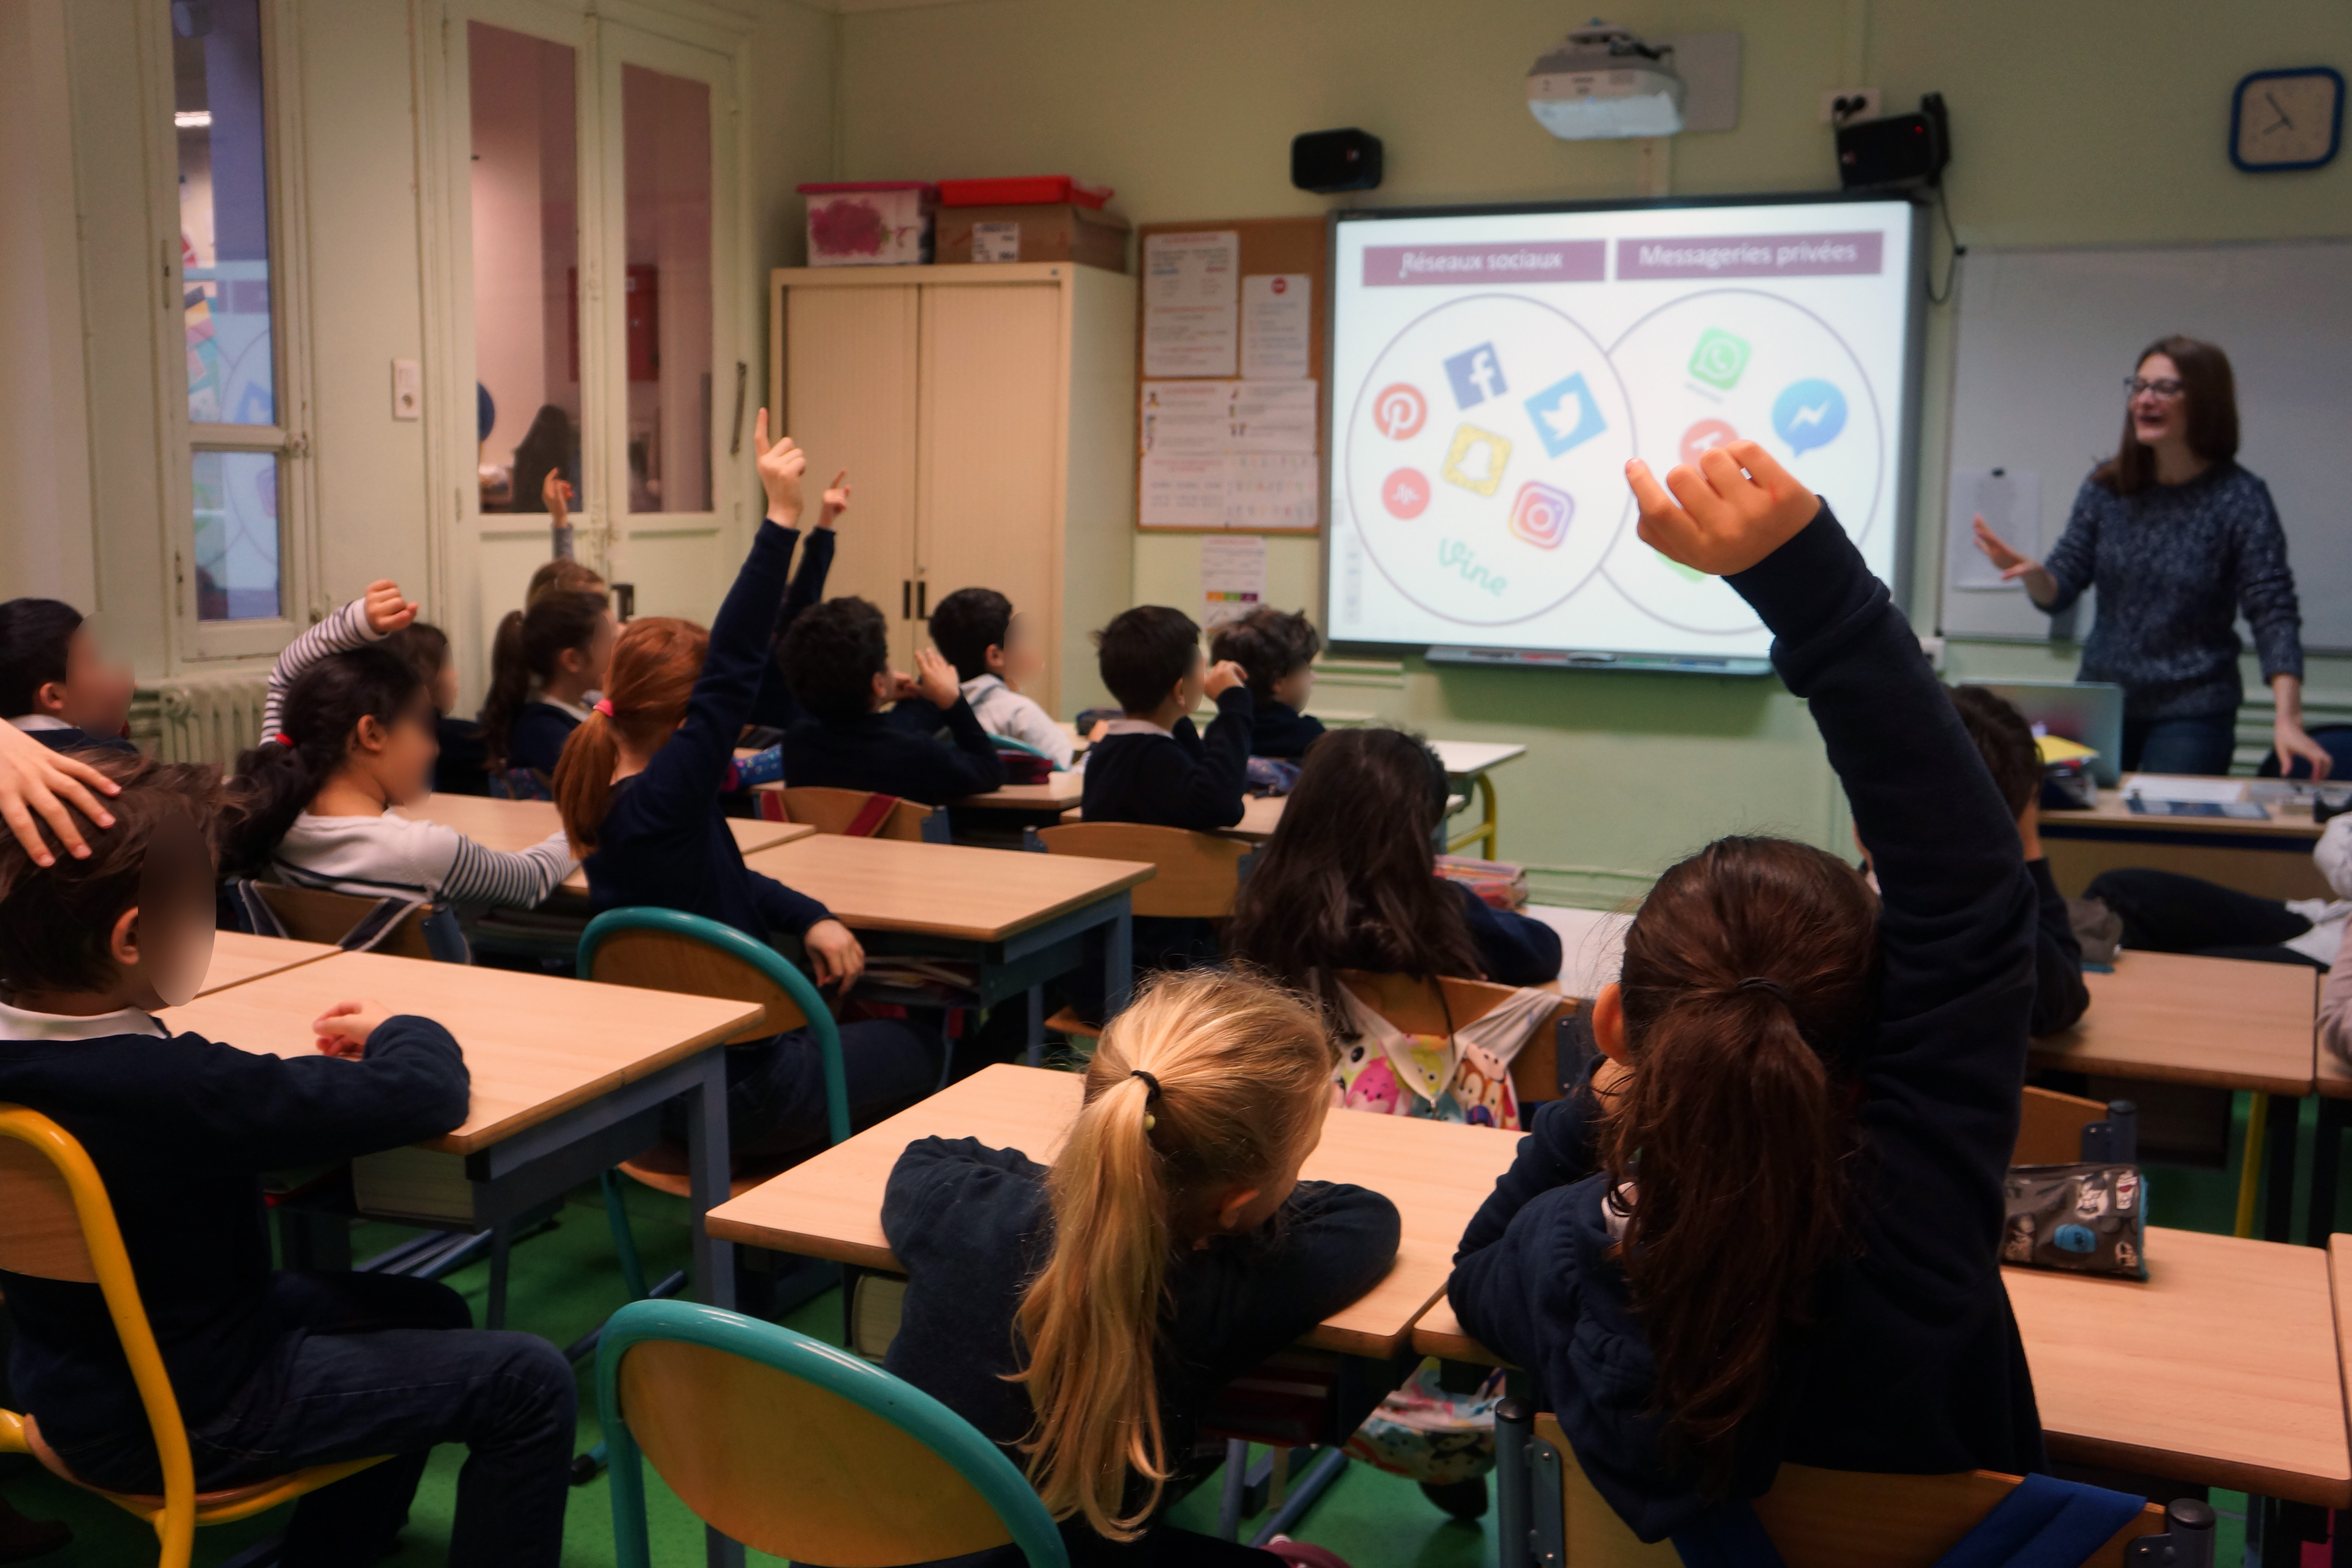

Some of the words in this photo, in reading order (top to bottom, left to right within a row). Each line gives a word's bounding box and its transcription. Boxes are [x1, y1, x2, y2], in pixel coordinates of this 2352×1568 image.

[1487, 249, 1563, 270] sociaux
[1639, 243, 1772, 270] Messageries
[1777, 240, 1858, 268] privées
[1438, 537, 1507, 596] Vine
